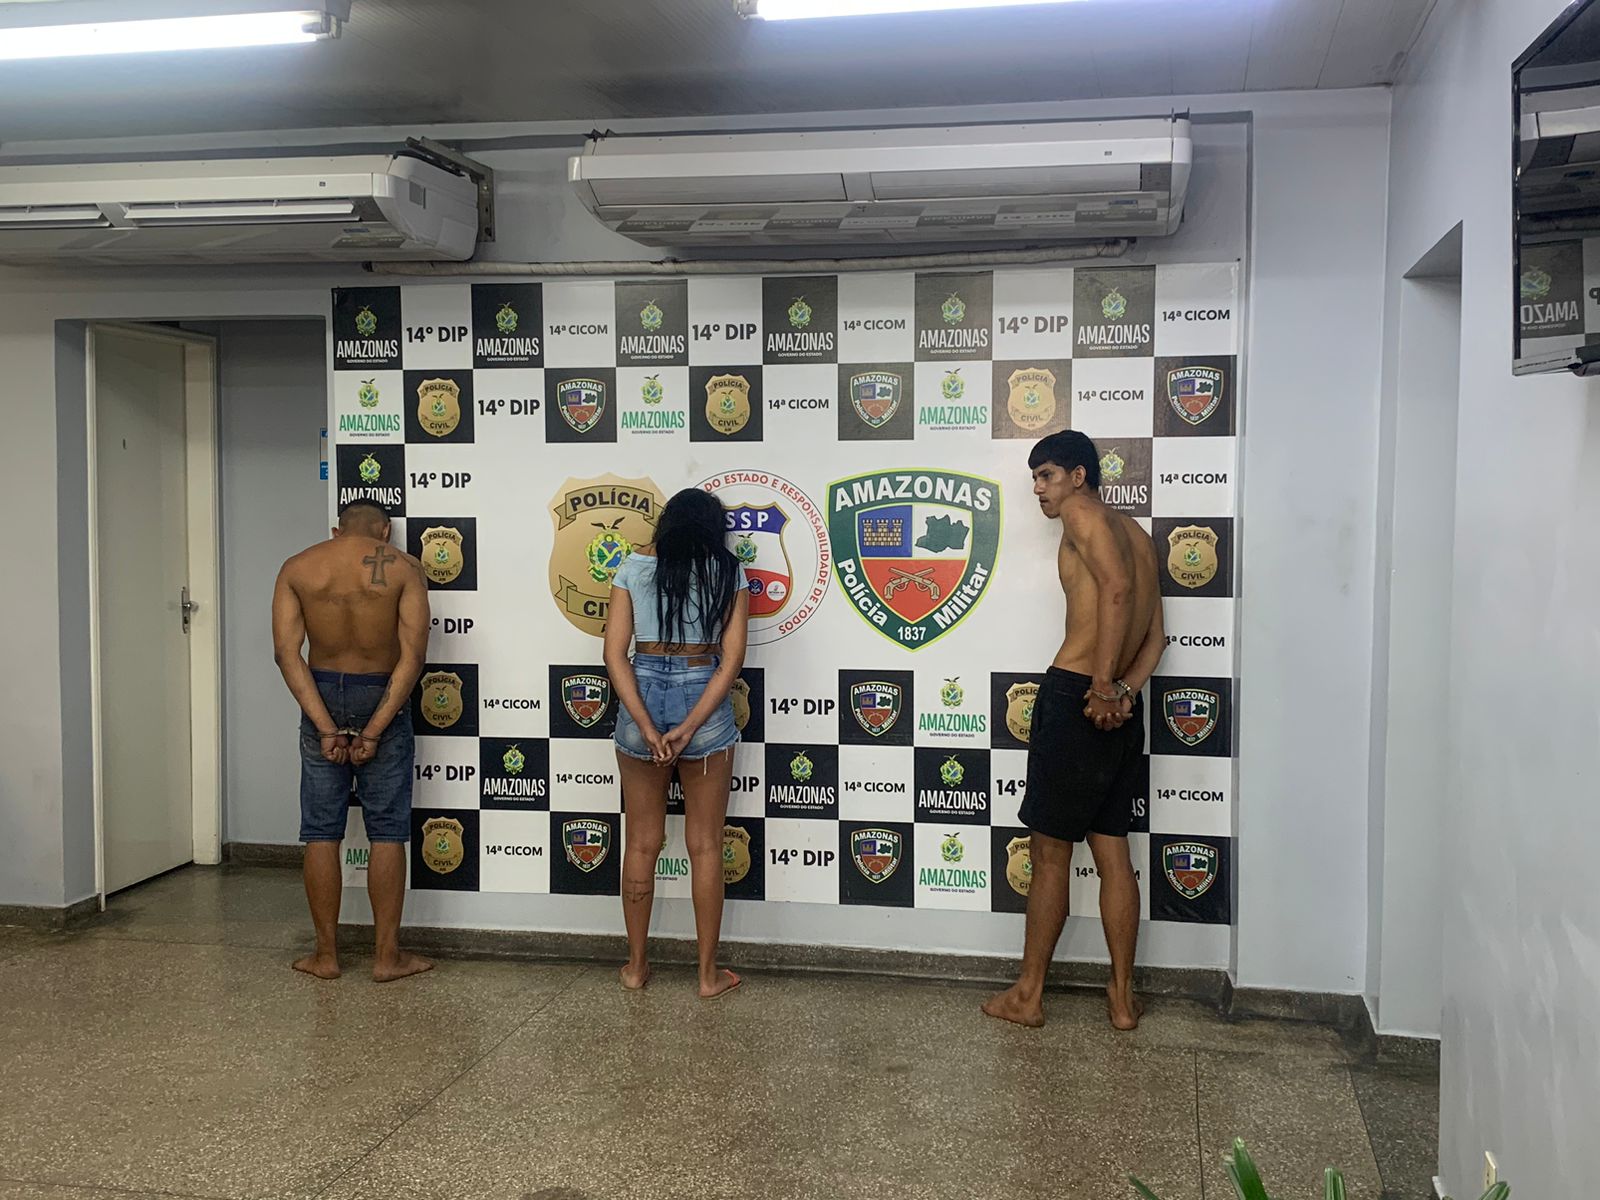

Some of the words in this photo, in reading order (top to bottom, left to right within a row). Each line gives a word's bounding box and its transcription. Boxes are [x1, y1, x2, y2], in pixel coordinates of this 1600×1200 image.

[1184, 309, 1230, 321] CICOM
[569, 325, 608, 335] CICOM
[726, 324, 757, 340] DIP
[864, 319, 905, 330] CICOM
[1034, 316, 1069, 333] DIP
[438, 326, 468, 342] DIP
[919, 328, 988, 348] AMAZONAS
[1078, 324, 1149, 345] AMAZONAS
[337, 340, 398, 358] AMAZONAS
[477, 338, 539, 356] AMAZONAS
[620, 335, 684, 354] AMAZONAS
[767, 332, 833, 352] AMAZONAS
[853, 374, 899, 387] AMAZONAS
[1171, 369, 1220, 381] AMAZONAS
[425, 384, 453, 392] POLÍCIA
[560, 381, 603, 393] AMAZONAS
[713, 381, 743, 389] POLÍCIA
[1099, 390, 1144, 401] CICOM
[510, 400, 540, 415] DIP
[788, 399, 829, 409] CICOM
[882, 401, 898, 421] Militar
[1201, 397, 1219, 417] Militar
[339, 414, 400, 431] AMAZONAS
[588, 406, 603, 425] Militar
[621, 411, 685, 429] AMAZONAS
[919, 406, 987, 424] AMAZONAS
[441, 473, 472, 488] DIP
[704, 479, 721, 491] DO
[724, 473, 768, 484] ESTADO
[771, 480, 779, 488] E
[1182, 474, 1227, 484] CICOM
[570, 488, 650, 513] POLÍCIA
[835, 476, 992, 512] AMAZONAS
[1098, 485, 1147, 504] AZONAS
[428, 532, 456, 540] POLÍCIA
[780, 484, 829, 584] RESPONSABILIDADE
[1177, 532, 1210, 540] POLÍCIA
[810, 589, 823, 603] DE
[838, 558, 888, 627] Polícia
[933, 563, 989, 629] Militar
[444, 618, 474, 634] DIP
[778, 604, 813, 634] TODOS
[897, 627, 926, 640] 1837
[1180, 636, 1225, 647] CICOM
[428, 677, 456, 685] POLÍCIA
[565, 678, 607, 688] AMAZONAS
[854, 685, 899, 695] AMAZONAS
[1015, 688, 1039, 697] POLÍC
[1167, 691, 1216, 704] AMAZONAS
[502, 700, 541, 709] CICOM
[592, 703, 606, 720] Militar
[803, 700, 835, 715] DIP
[882, 710, 898, 730] Militar
[919, 713, 986, 732] AMAZONAS
[1197, 719, 1214, 739] Militar
[446, 766, 475, 781] DIP
[576, 774, 614, 785] CICOM
[483, 778, 546, 797] AMAZONAS
[729, 777, 759, 792] DIP
[864, 782, 905, 793] CICOM
[770, 785, 835, 804] AMAZONAS
[918, 790, 986, 810] AMAZONAS
[1179, 790, 1224, 802] CICOM
[566, 822, 608, 833] AMAZONAS
[724, 831, 743, 839] LÍCIA
[854, 832, 899, 844] AMAZONAS
[505, 846, 543, 856] CICOM
[592, 846, 607, 865] Militar
[803, 850, 835, 866] DIP
[1166, 845, 1215, 858] AMAZONAS
[655, 858, 688, 876] ONAS
[882, 857, 898, 876] Militar
[919, 868, 986, 888] AMAZONAS
[1197, 873, 1214, 892] Militar
